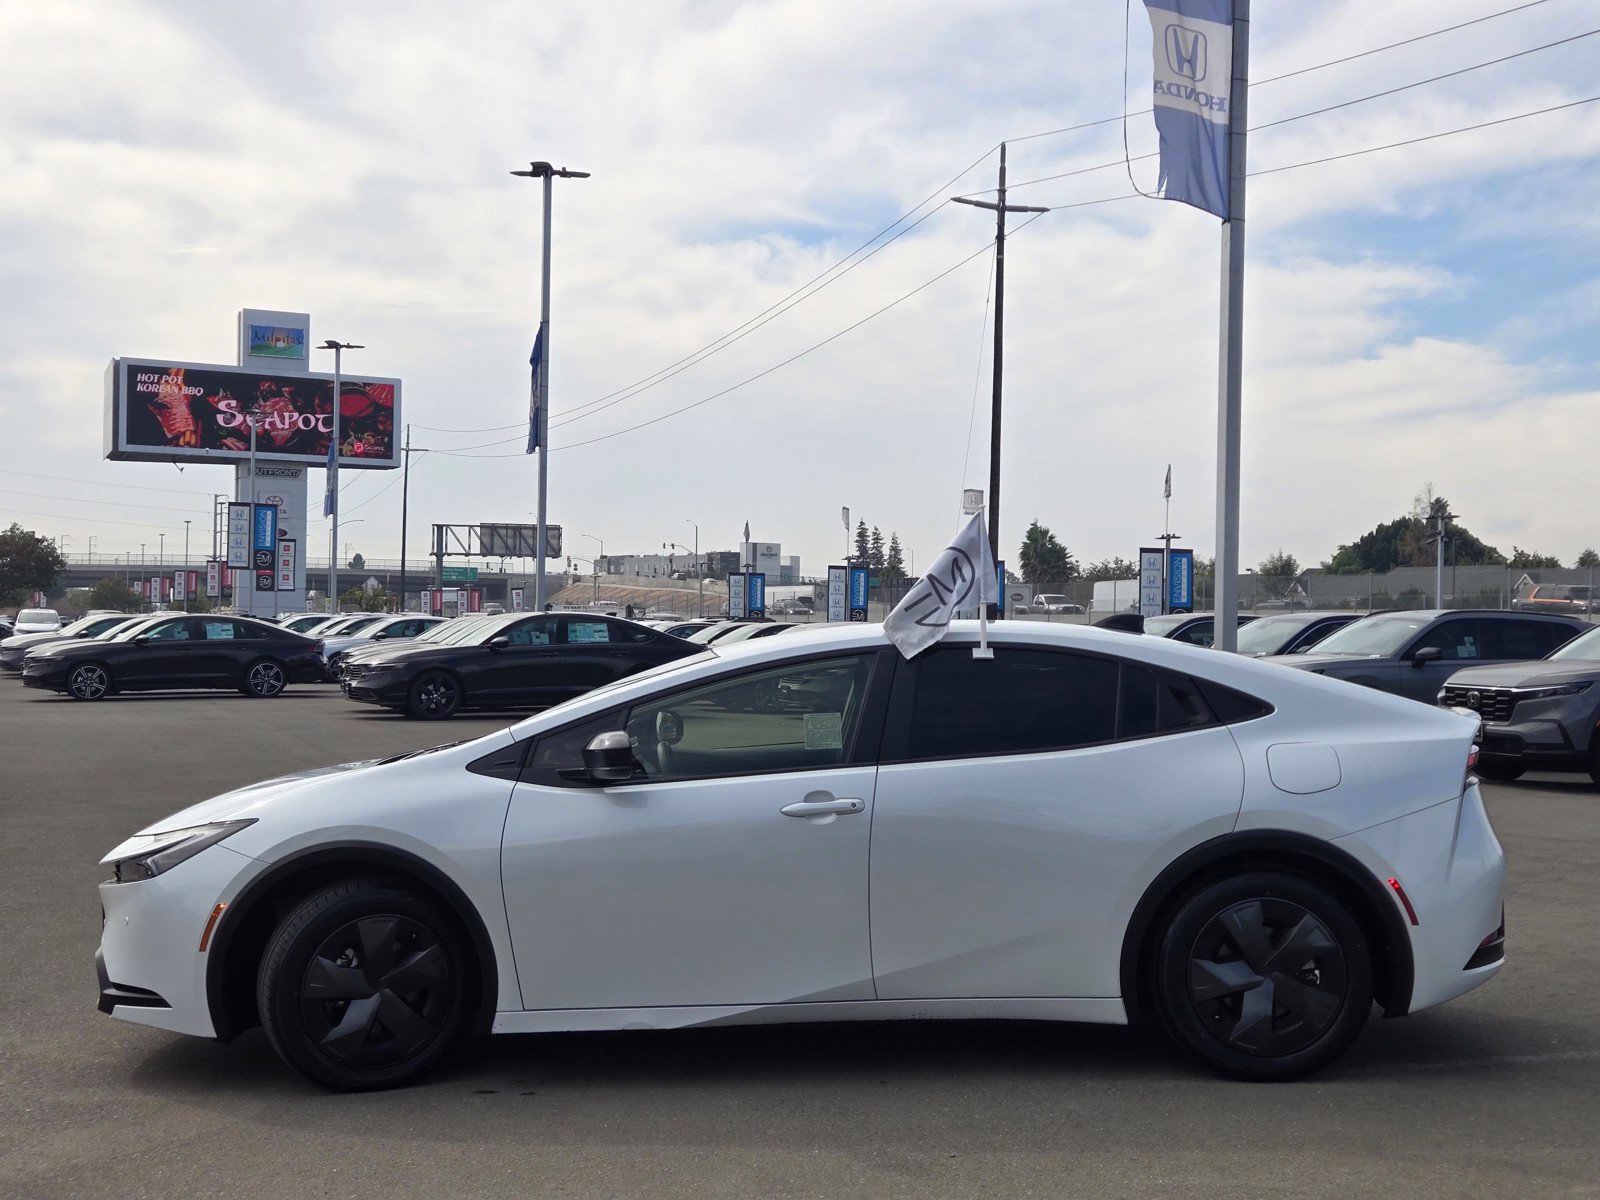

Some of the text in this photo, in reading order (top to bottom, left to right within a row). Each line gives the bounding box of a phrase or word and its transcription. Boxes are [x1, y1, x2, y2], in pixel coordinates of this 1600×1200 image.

[136, 383, 204, 396] KOREAN BBQ
[137, 373, 184, 384] HOT POT
[257, 509, 267, 547] ENVISION
[1173, 556, 1182, 603] ENVISION
